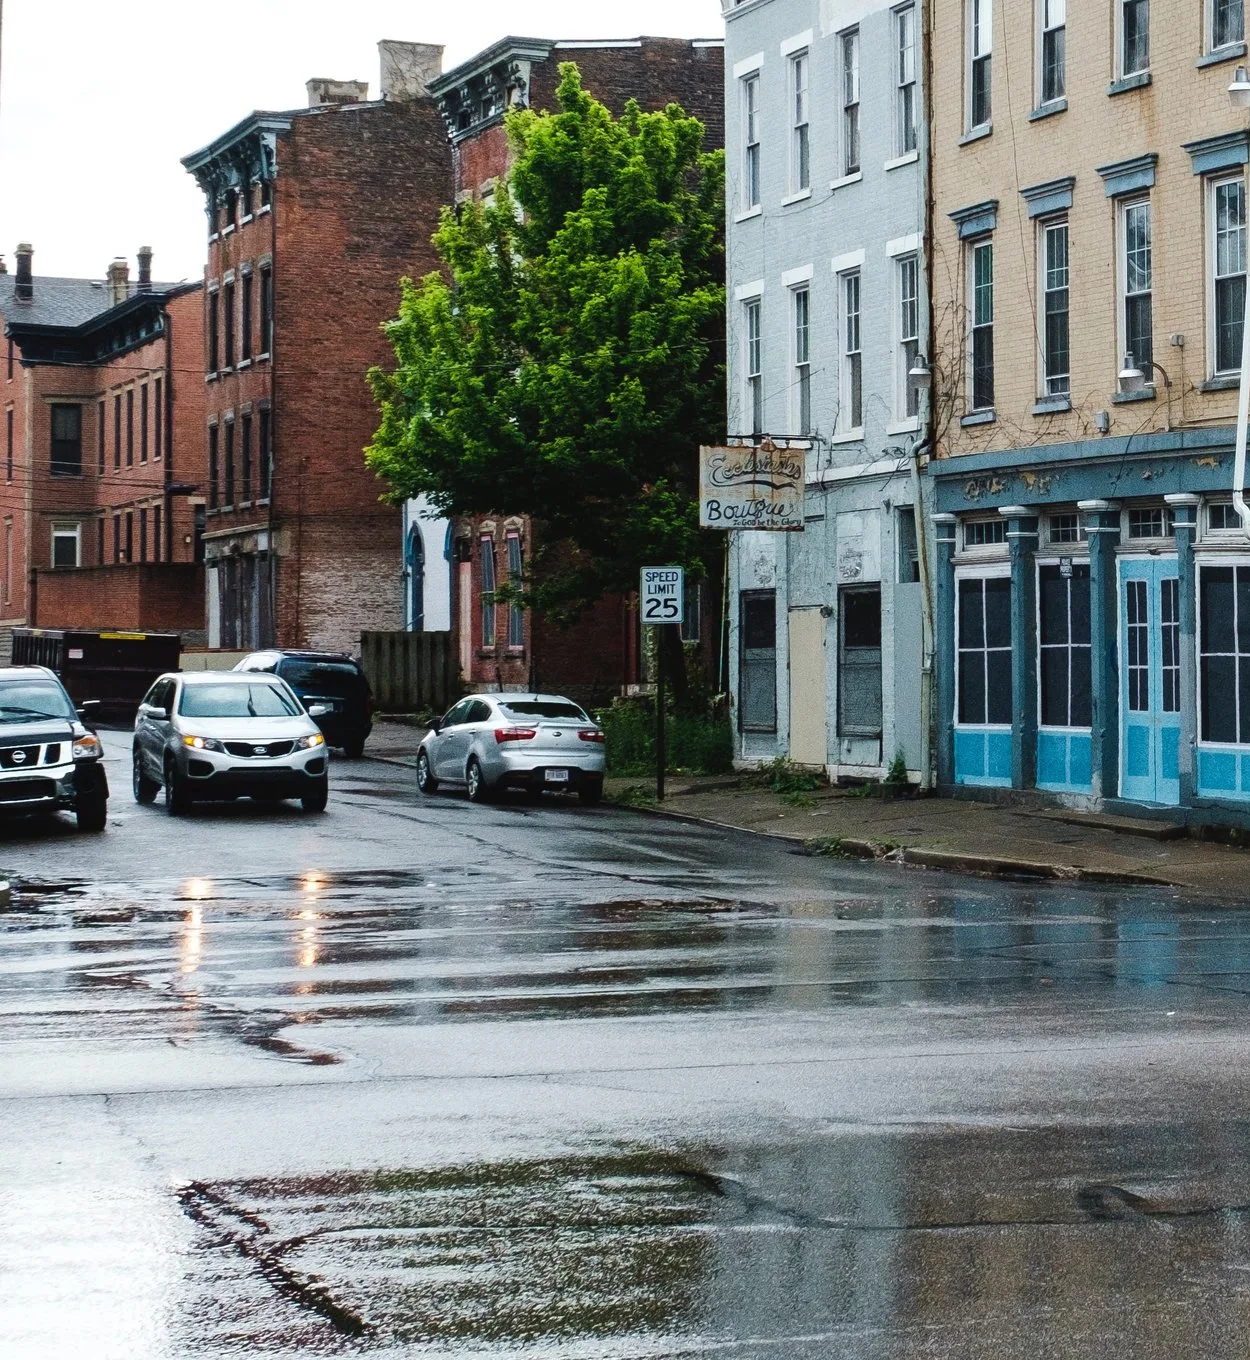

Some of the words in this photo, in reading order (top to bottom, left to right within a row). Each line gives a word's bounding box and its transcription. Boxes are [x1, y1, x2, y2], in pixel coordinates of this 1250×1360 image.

[645, 572, 678, 582] SPEED
[648, 584, 675, 594] LIMIT
[646, 598, 678, 618] 25
